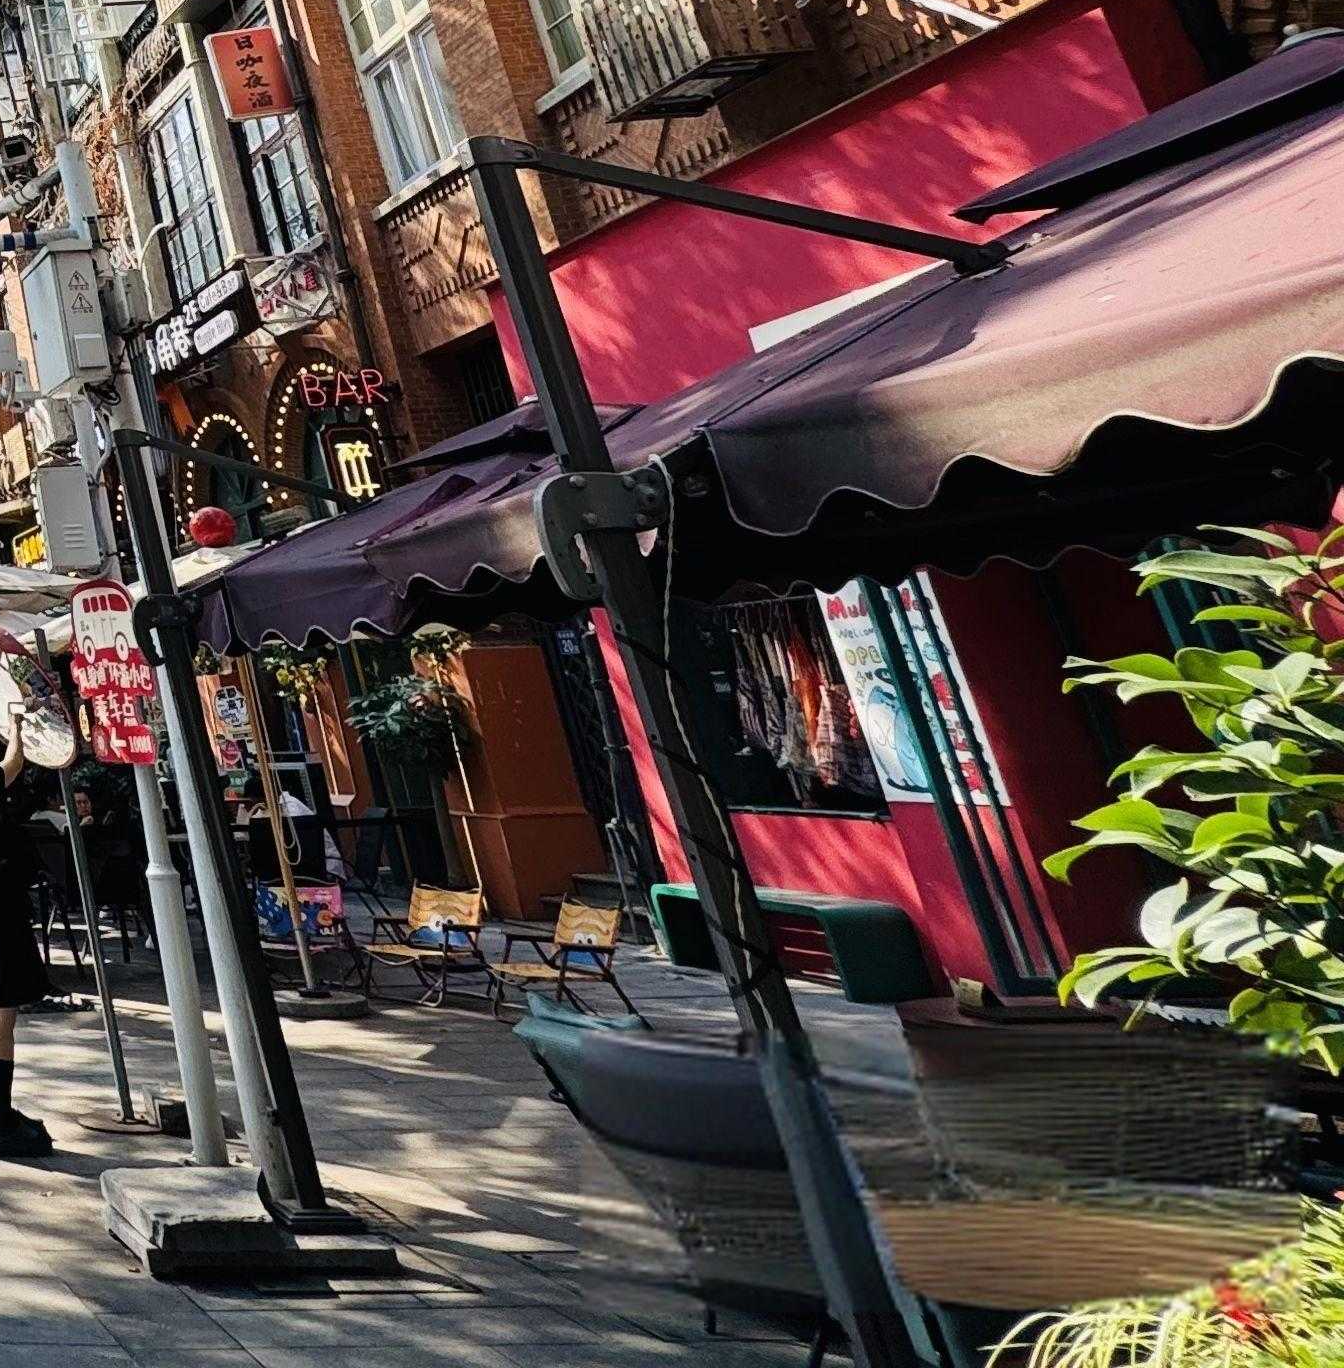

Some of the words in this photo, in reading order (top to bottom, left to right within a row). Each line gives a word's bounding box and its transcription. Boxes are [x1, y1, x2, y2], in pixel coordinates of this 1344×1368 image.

[234, 35, 274, 109] 日咖夜酒
[300, 369, 389, 407] BAR
